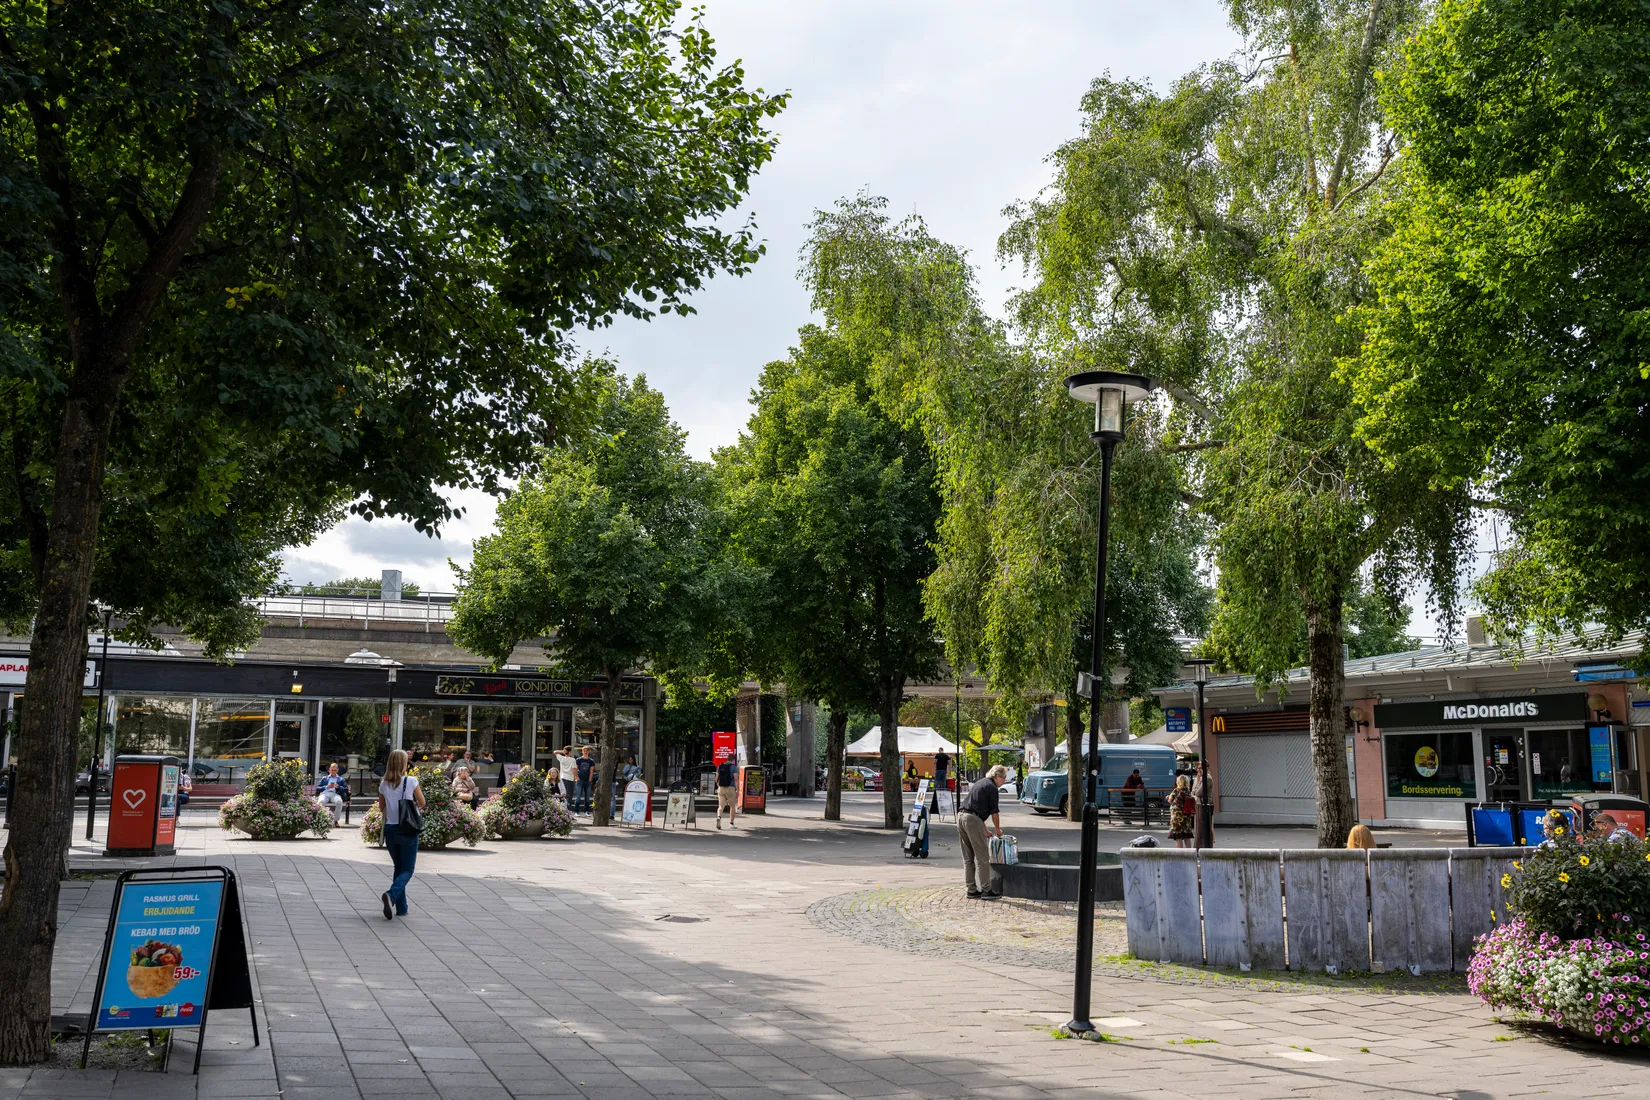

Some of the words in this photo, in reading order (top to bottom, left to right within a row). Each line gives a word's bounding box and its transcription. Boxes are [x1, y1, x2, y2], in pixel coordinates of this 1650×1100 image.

[515, 681, 571, 692] KONDITORI
[1443, 702, 1538, 719] McDonald's
[1402, 785, 1463, 796] Bordsservering.
[143, 895, 176, 903] RASMUS
[143, 906, 196, 916] ERBJUDANDE
[131, 928, 157, 937] KEBAB
[159, 927, 177, 936] MED
[178, 925, 200, 935] BRÖD
[173, 966, 200, 979] 59:-
